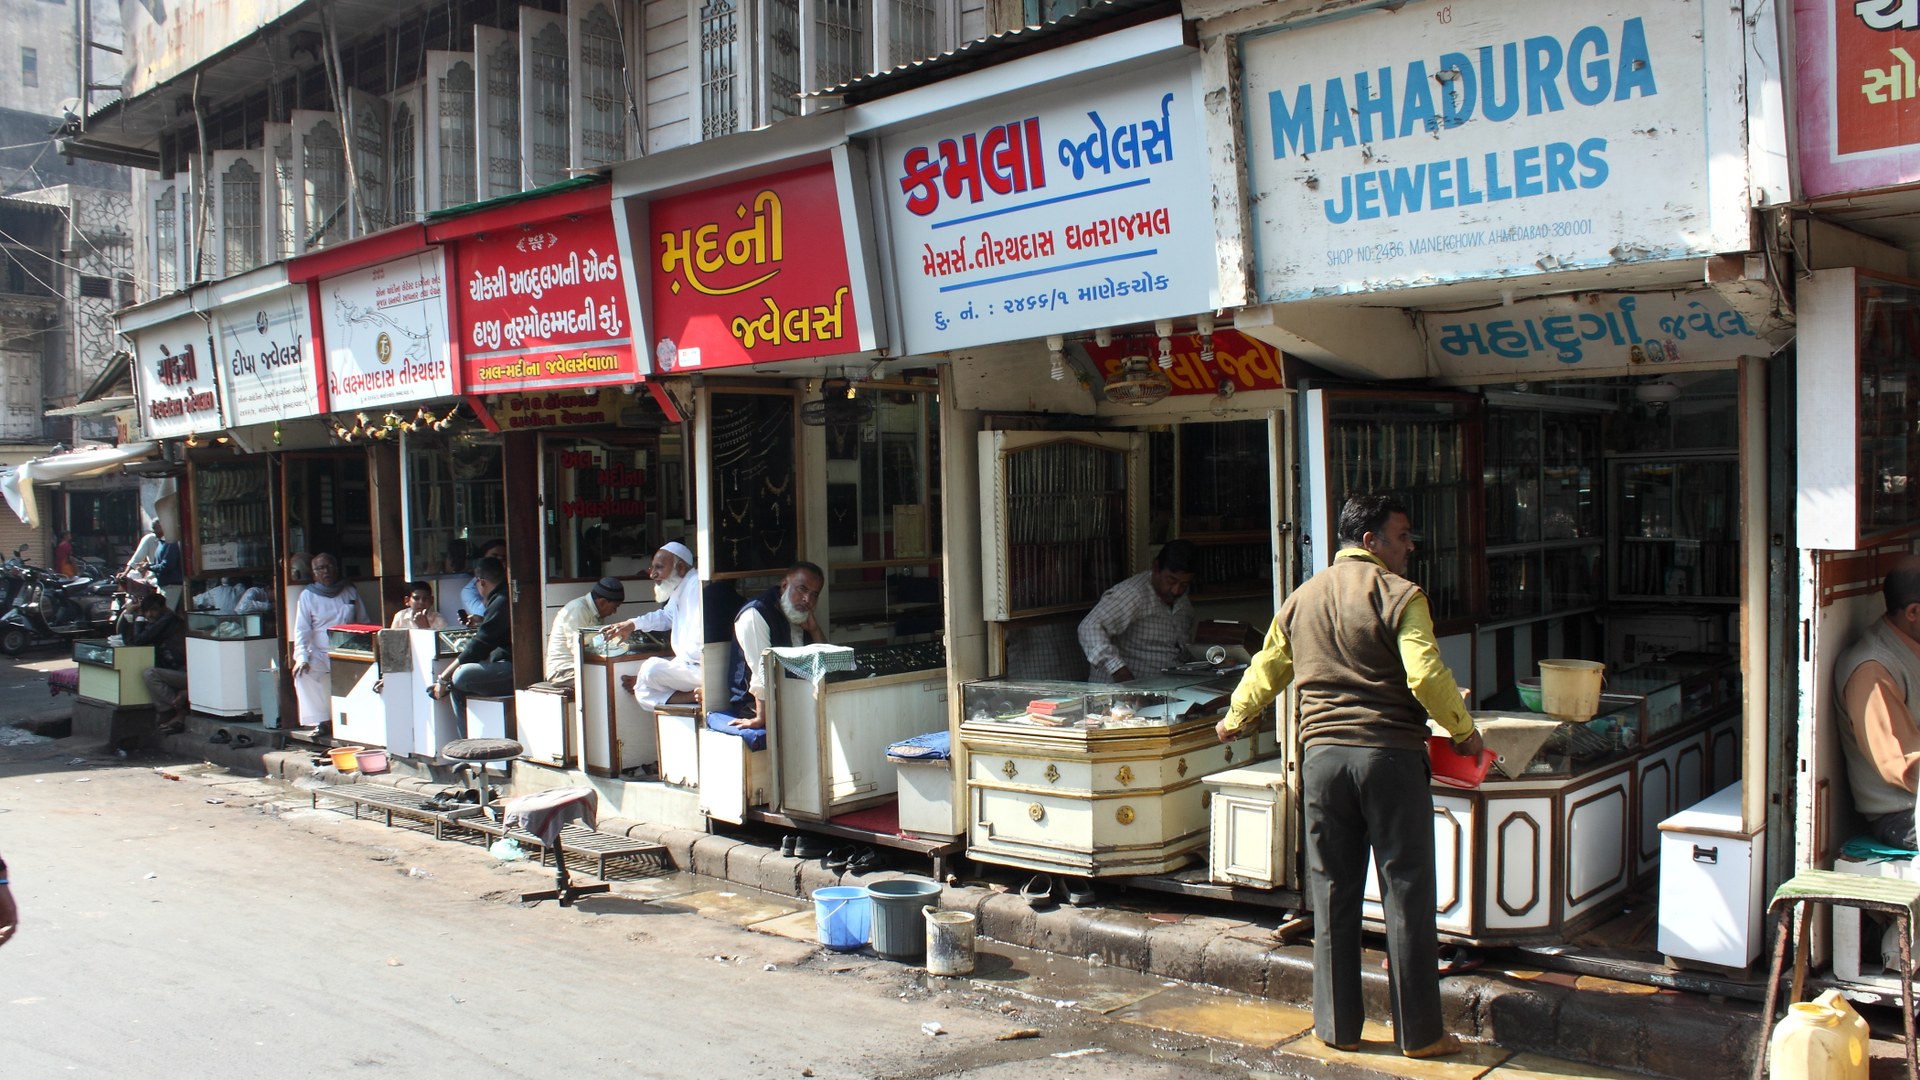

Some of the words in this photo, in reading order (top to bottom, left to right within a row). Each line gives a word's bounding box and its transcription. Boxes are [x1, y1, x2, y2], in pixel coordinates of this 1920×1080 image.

[1268, 16, 1659, 160] MAHADURGA
[899, 116, 1047, 217] કમલા
[1058, 92, 1174, 181] જ્વેલર્સ
[1324, 137, 1609, 224] JEWELLERS
[469, 265, 507, 301] ચોકસી
[509, 251, 580, 300] અબ્દુલગની
[582, 248, 617, 283] એન્ડ
[1327, 248, 1353, 267] SHOP
[731, 286, 849, 350] જ્વેલર્સ
[934, 310, 951, 331] દુ.
[1077, 272, 1170, 303] માણેકચોક
[1440, 295, 1642, 364] મહાદુર્ગા
[232, 349, 256, 376] દીપા
[260, 334, 303, 370] જ્વેલર્સ
[473, 319, 501, 350] હાજી
[343, 369, 395, 395] લક્ષ્મણદાસ
